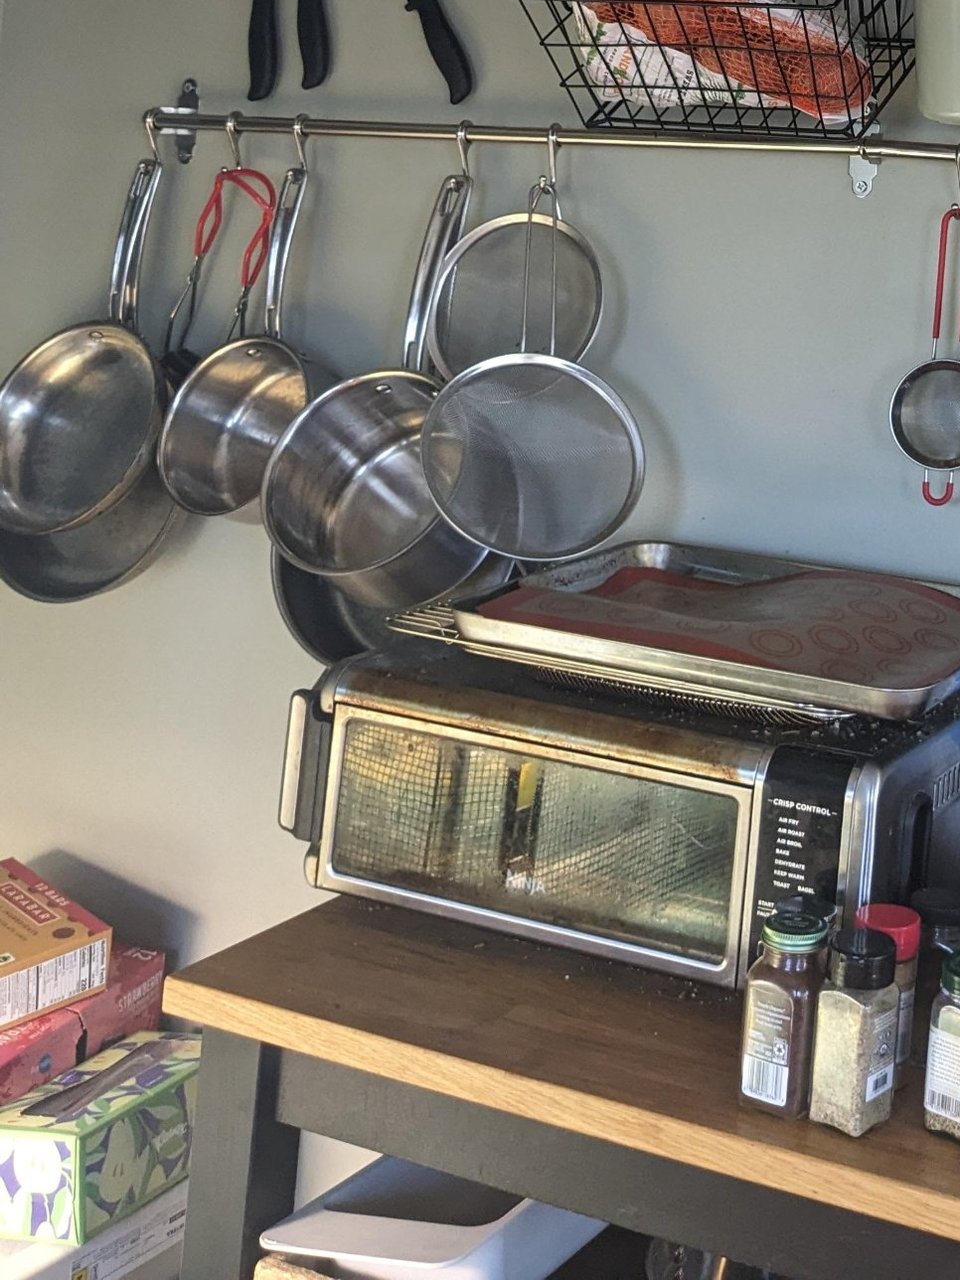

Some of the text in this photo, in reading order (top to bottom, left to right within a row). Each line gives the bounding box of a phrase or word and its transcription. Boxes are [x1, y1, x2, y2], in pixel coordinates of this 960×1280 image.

[773, 799, 832, 817] CRISP CONTROL
[778, 816, 800, 827] AIR FRY
[788, 829, 806, 838] ROAST
[776, 837, 787, 845] AIR
[775, 848, 790, 857] BAKE
[774, 858, 806, 871] DEHYDRATE
[774, 869, 805, 881] KEEP WARM
[773, 880, 816, 895] TOAST BAGEL
[758, 899, 775, 908] START
[118, 969, 163, 1013] STRAWBERRY
